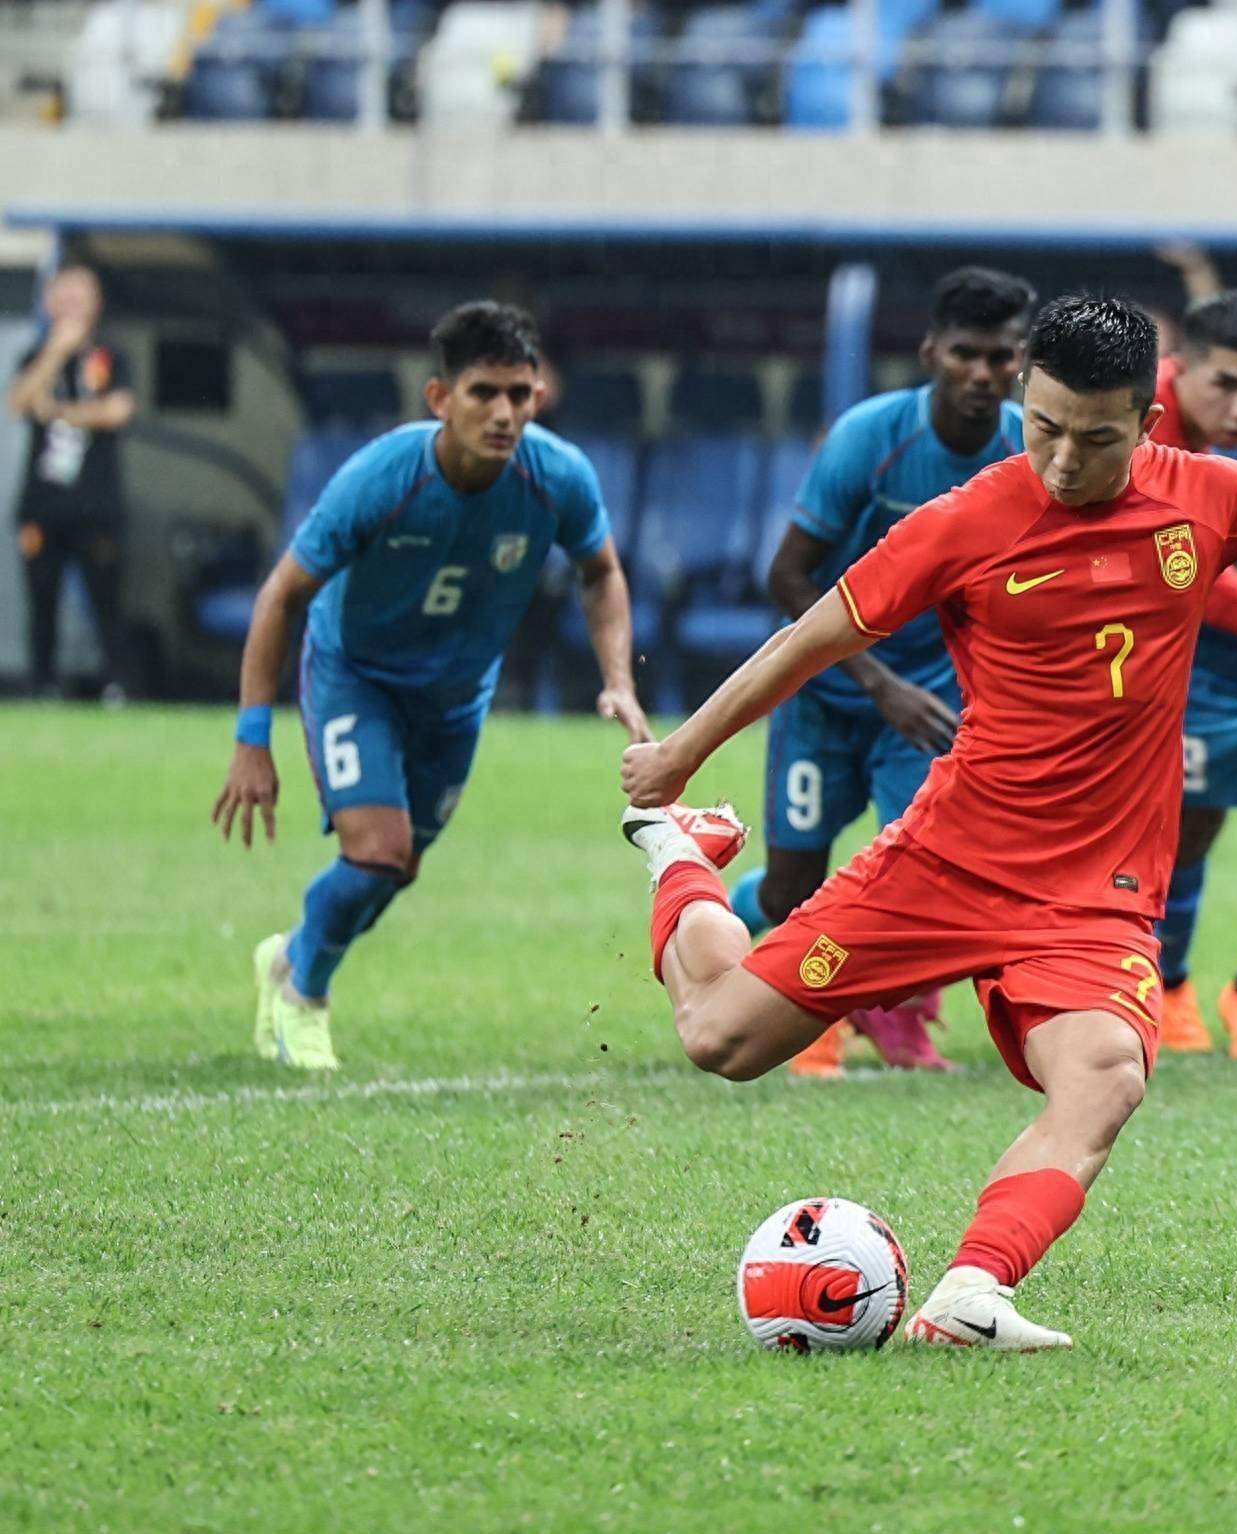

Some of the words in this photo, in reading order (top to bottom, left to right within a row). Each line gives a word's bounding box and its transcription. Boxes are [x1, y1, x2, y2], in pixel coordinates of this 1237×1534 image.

[422, 566, 469, 616] 6
[1095, 623, 1134, 698] 7
[323, 714, 361, 791] 6
[787, 760, 822, 831] 9
